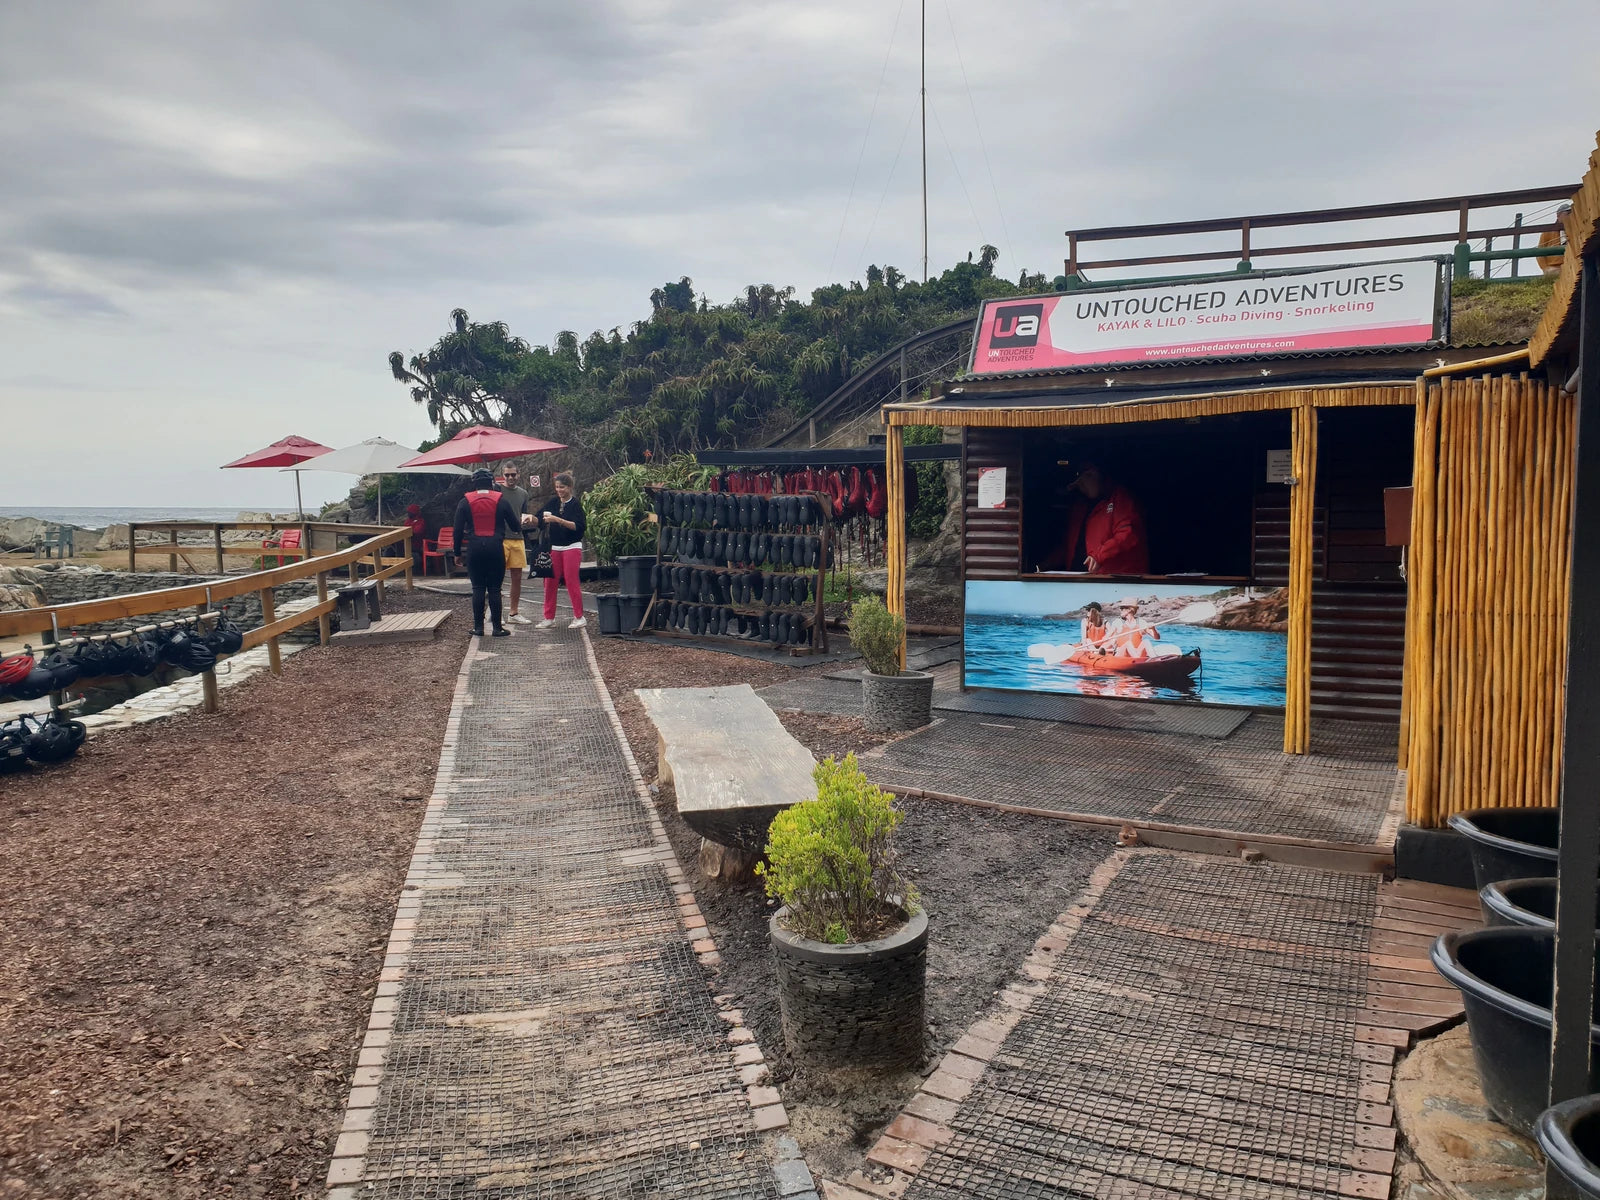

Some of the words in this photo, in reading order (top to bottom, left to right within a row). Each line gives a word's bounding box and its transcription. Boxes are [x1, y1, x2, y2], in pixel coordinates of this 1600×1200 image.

[1076, 291, 1226, 320] UNTOUCHED
[1235, 274, 1404, 306] ADVENTURES
[1097, 319, 1140, 332] KAYAK
[1143, 319, 1153, 328] &
[1157, 316, 1186, 328] LILO
[1196, 312, 1236, 325] Scuba
[1240, 310, 1283, 321] Diving
[1295, 301, 1375, 317] Snorkeling
[988, 348, 1035, 357] UNTOUCHED
[1145, 340, 1295, 356] www.untouchedadventures.com
[987, 354, 1034, 363] ADVENTURES
